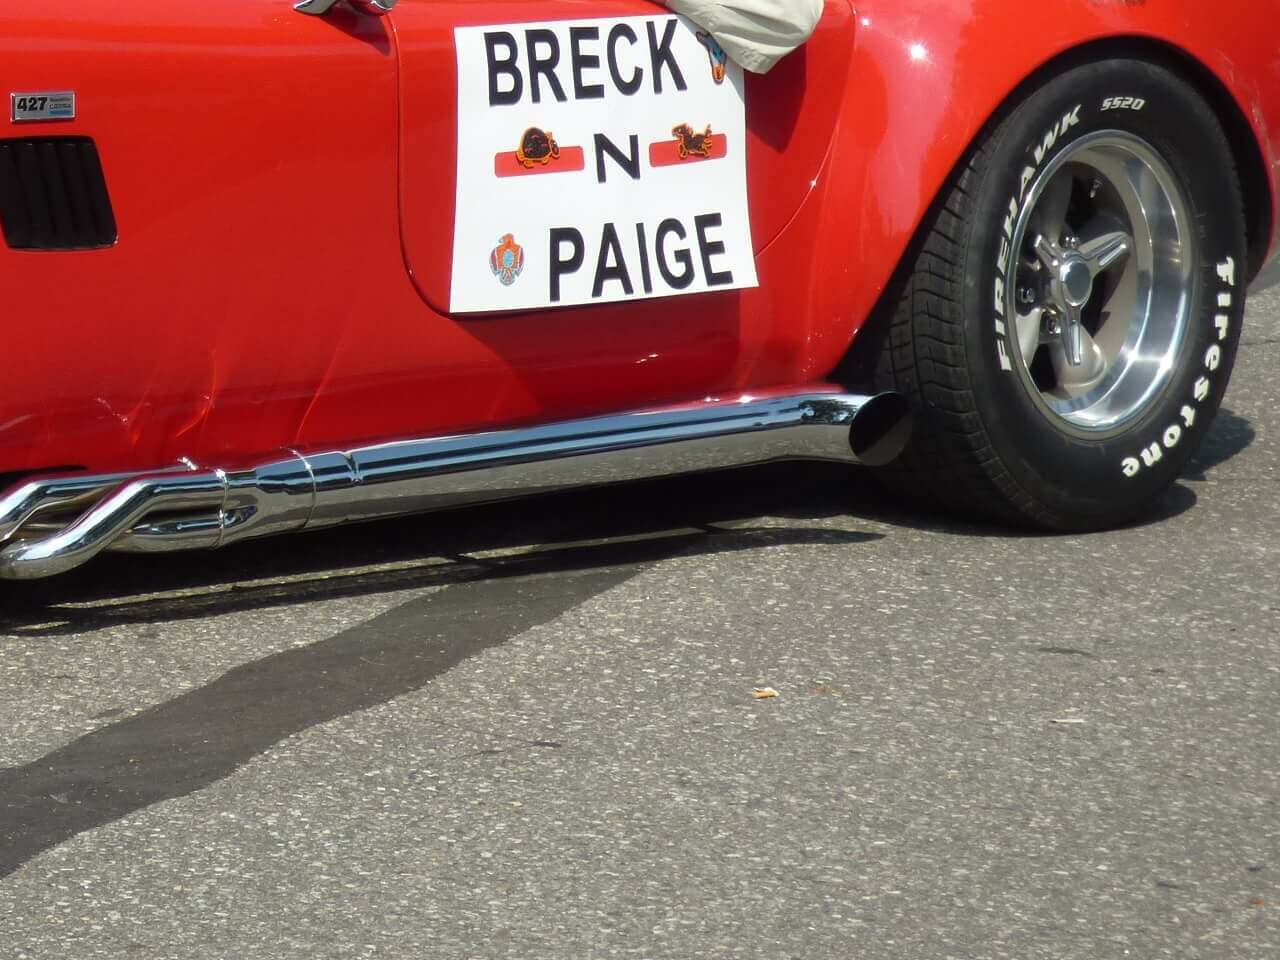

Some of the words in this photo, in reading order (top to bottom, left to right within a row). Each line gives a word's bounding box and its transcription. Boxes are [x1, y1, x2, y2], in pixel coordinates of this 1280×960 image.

[17, 96, 48, 112] 427
[483, 18, 688, 107] BRECK
[593, 133, 641, 183] N
[549, 212, 734, 303] PAIGE
[994, 103, 1081, 372] FIREHAWK
[1121, 256, 1236, 477] Firestone
